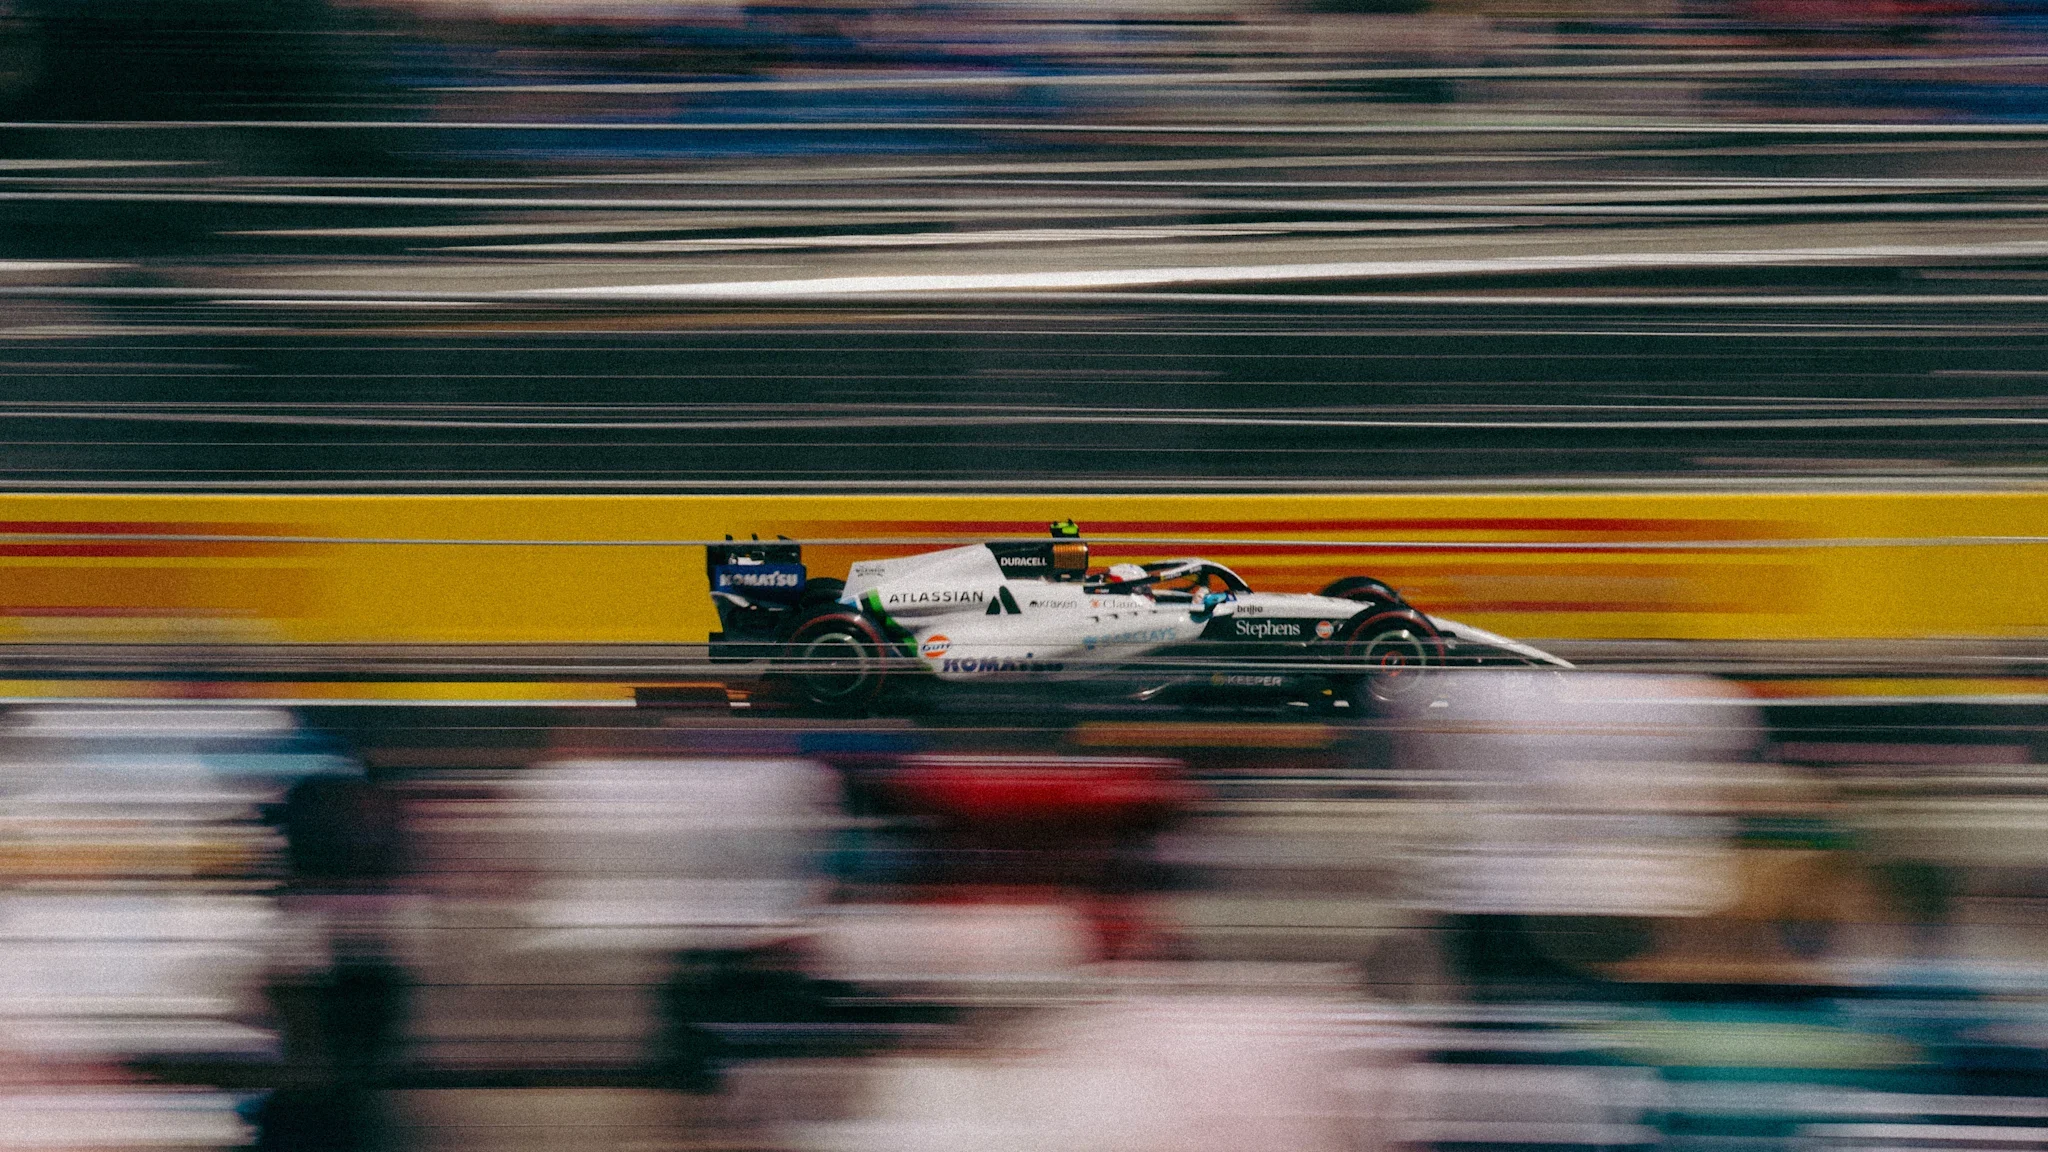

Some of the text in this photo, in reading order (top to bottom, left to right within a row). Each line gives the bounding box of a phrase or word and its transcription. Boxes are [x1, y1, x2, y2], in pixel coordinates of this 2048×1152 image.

[1000, 556, 1047, 567] DURACELL
[719, 570, 798, 587] KOMATSU
[889, 590, 984, 604] ATLASSIAN
[1235, 620, 1301, 639] Stephens
[942, 653, 1064, 672] KOMA
[1227, 675, 1283, 687] KEEPER
